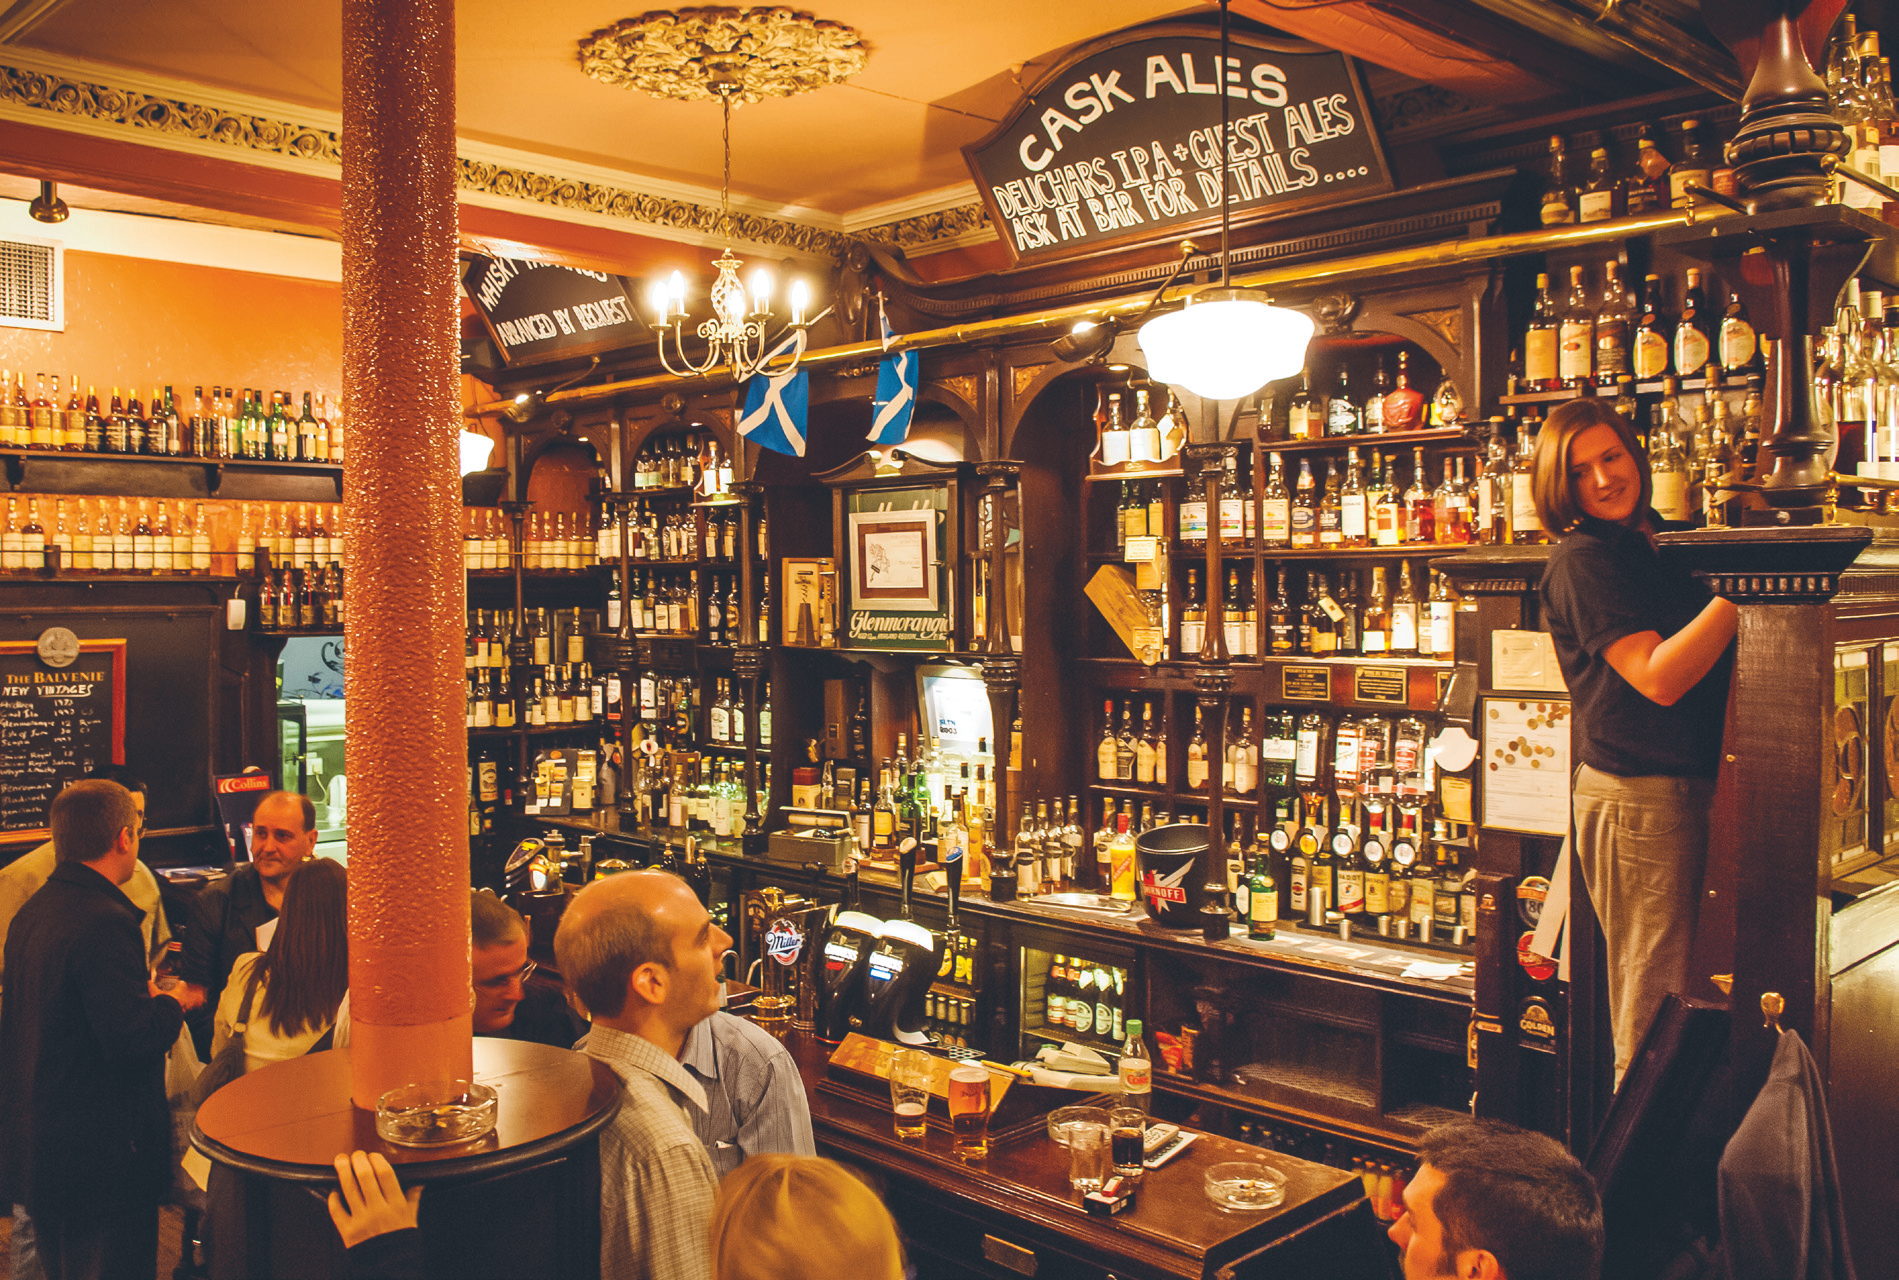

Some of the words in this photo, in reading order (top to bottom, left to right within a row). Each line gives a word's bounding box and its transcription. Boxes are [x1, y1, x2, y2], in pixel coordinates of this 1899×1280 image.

[1018, 69, 1135, 171] CASK
[1146, 52, 1288, 108] ALES
[992, 157, 1116, 219] DEUCHARS
[1188, 112, 1270, 170] GUEST
[1283, 93, 1355, 149] ALES
[1012, 211, 1058, 251] ASK
[1057, 199, 1088, 242] AT
[1089, 189, 1144, 233] BAR
[1140, 176, 1199, 221] FOR
[477, 256, 519, 312] WHISKY
[496, 313, 558, 348] ARRANGED
[553, 307, 577, 335] BY
[573, 295, 633, 331] REQUEST
[2, 686, 30, 696] NEW
[36, 684, 94, 697] VINTAGES
[6, 674, 30, 684] THE
[34, 671, 105, 684] BALVENIE
[767, 931, 800, 950] Miller
